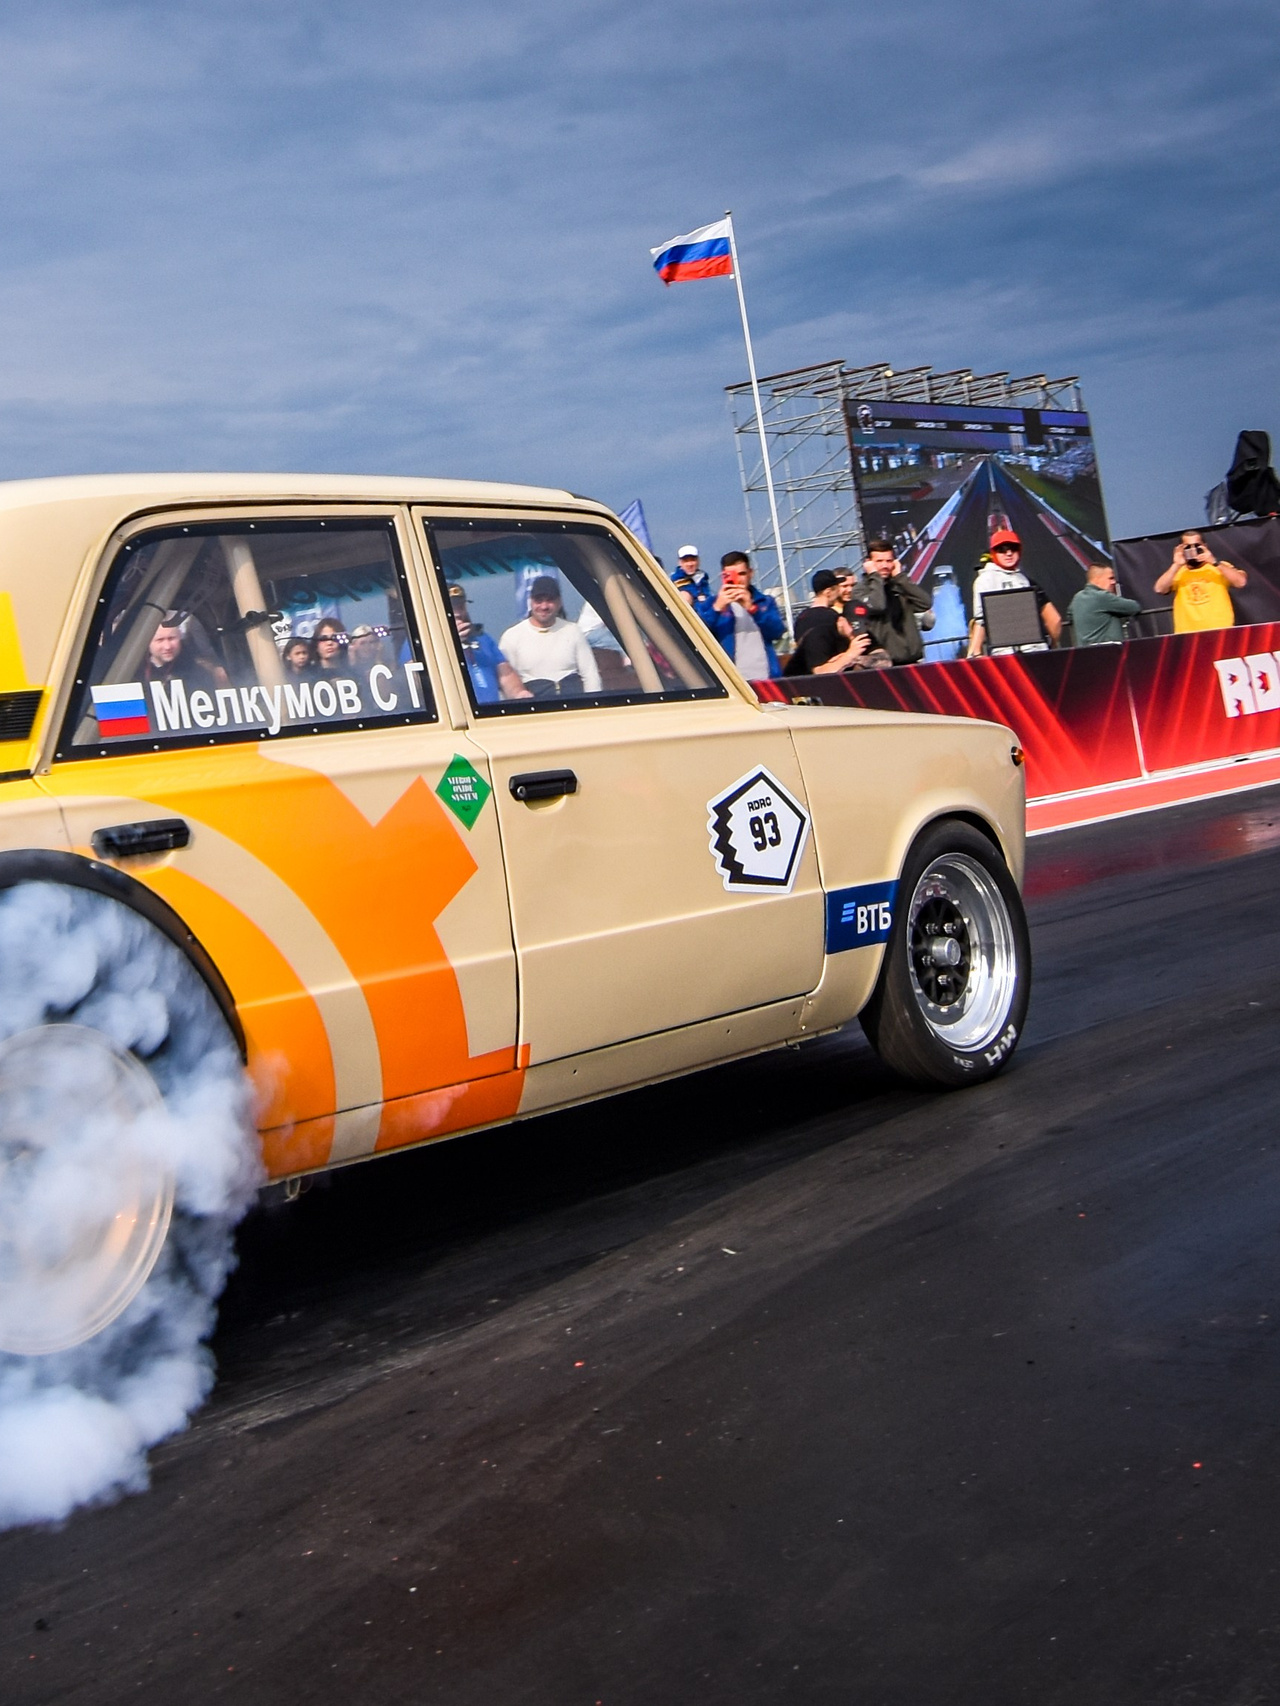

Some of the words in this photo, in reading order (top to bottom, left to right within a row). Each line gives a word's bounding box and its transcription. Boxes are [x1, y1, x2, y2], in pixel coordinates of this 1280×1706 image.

[149, 679, 362, 735] Мелкумов
[369, 664, 398, 712] С
[404, 662, 425, 708] Г
[1213, 650, 1280, 718] RD
[451, 792, 478, 801] SYSTEM
[747, 796, 772, 812] RDRC
[749, 811, 782, 852] 93
[856, 901, 892, 934] ВТБ
